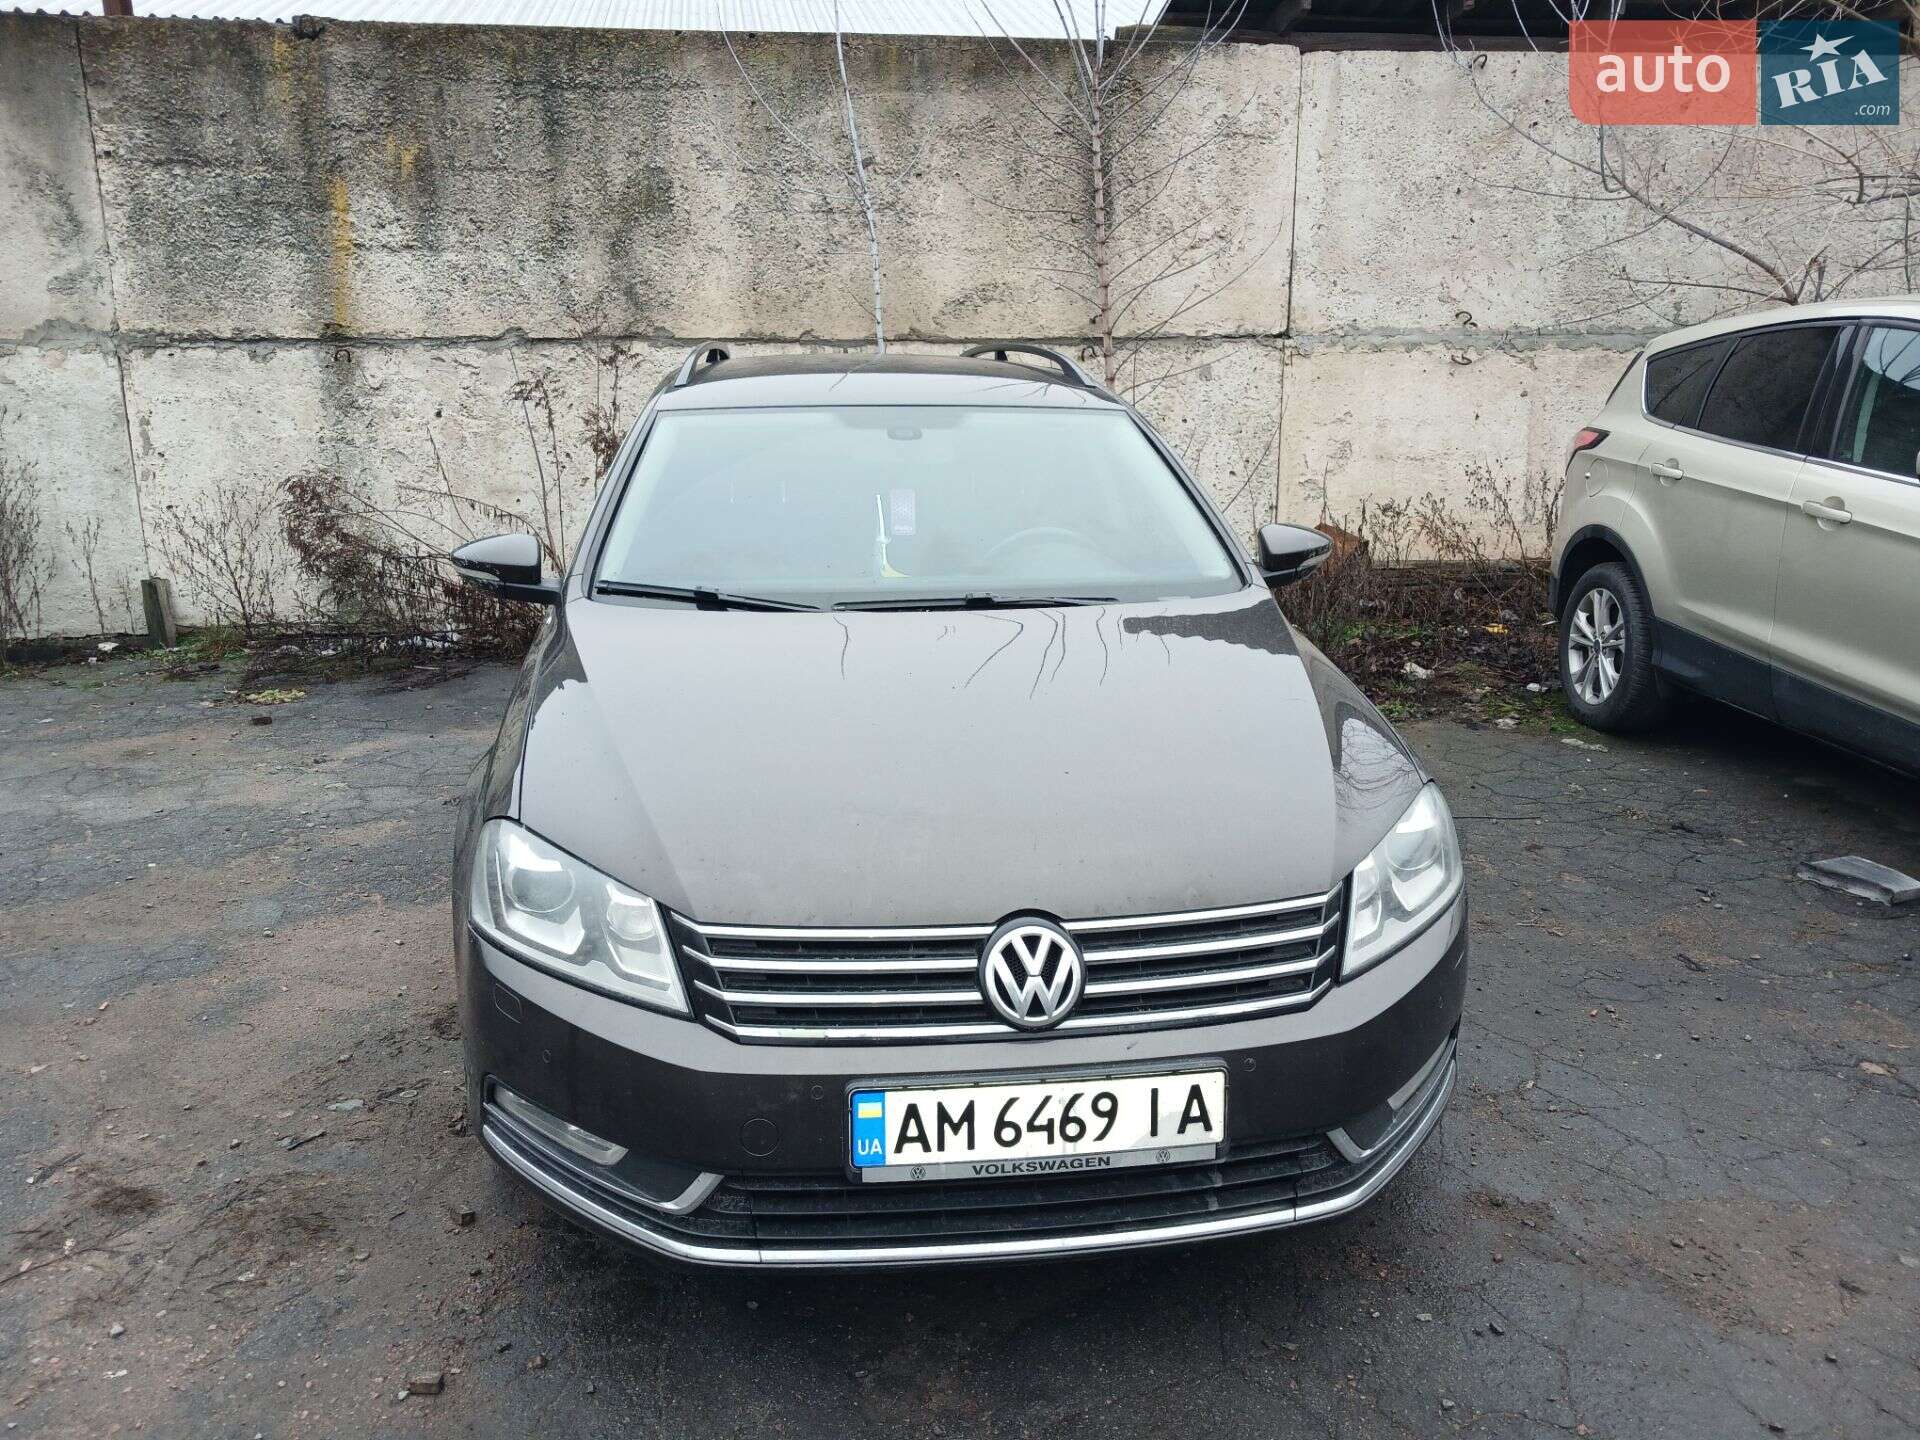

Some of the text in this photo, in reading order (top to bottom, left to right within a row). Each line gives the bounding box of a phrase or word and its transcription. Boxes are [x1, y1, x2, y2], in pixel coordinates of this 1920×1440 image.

[893, 1084, 1213, 1154] AM 6469 IA
[857, 1137, 883, 1156] UA
[972, 1156, 1111, 1176] VOLKSWAGEN
